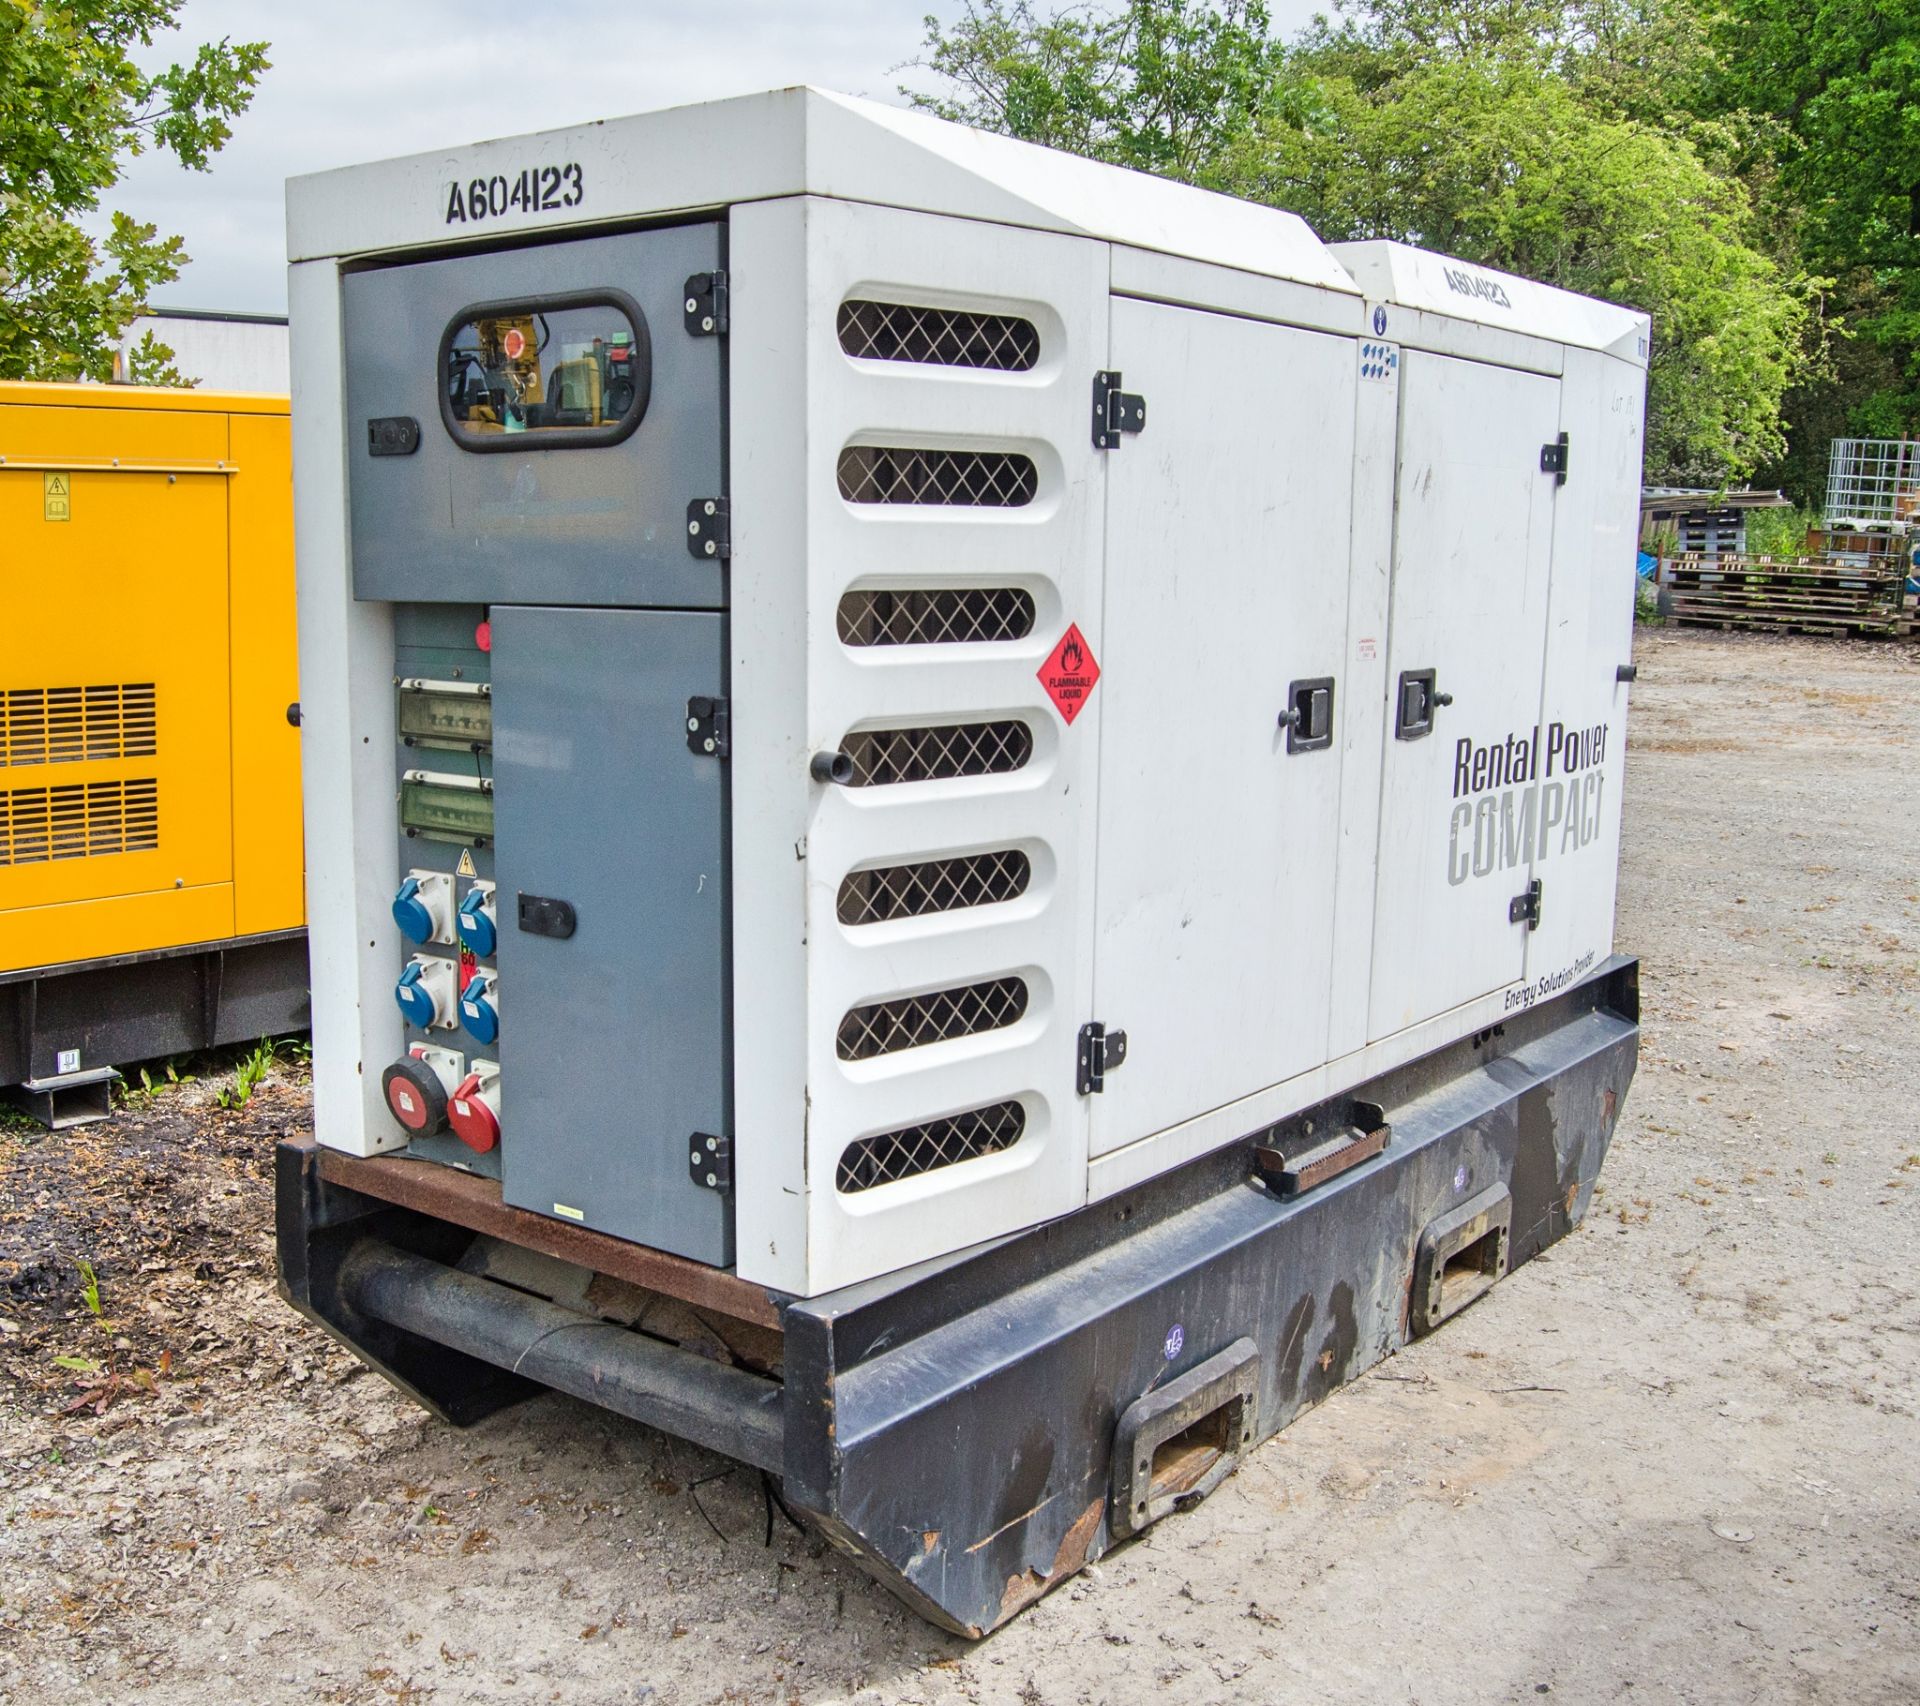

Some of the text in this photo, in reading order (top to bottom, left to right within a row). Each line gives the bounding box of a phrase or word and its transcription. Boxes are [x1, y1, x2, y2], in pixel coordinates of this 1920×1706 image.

[445, 162, 584, 224] A604123
[1442, 266, 1512, 309] A604123
[1049, 677, 1091, 688] FLAMMABLE
[1059, 689, 1082, 699] LIQUID
[1067, 703, 1073, 714] 3
[1453, 721, 1609, 799] Rental Power
[1448, 769, 1605, 887] COMPACT
[1504, 984, 1537, 1011] Energy
